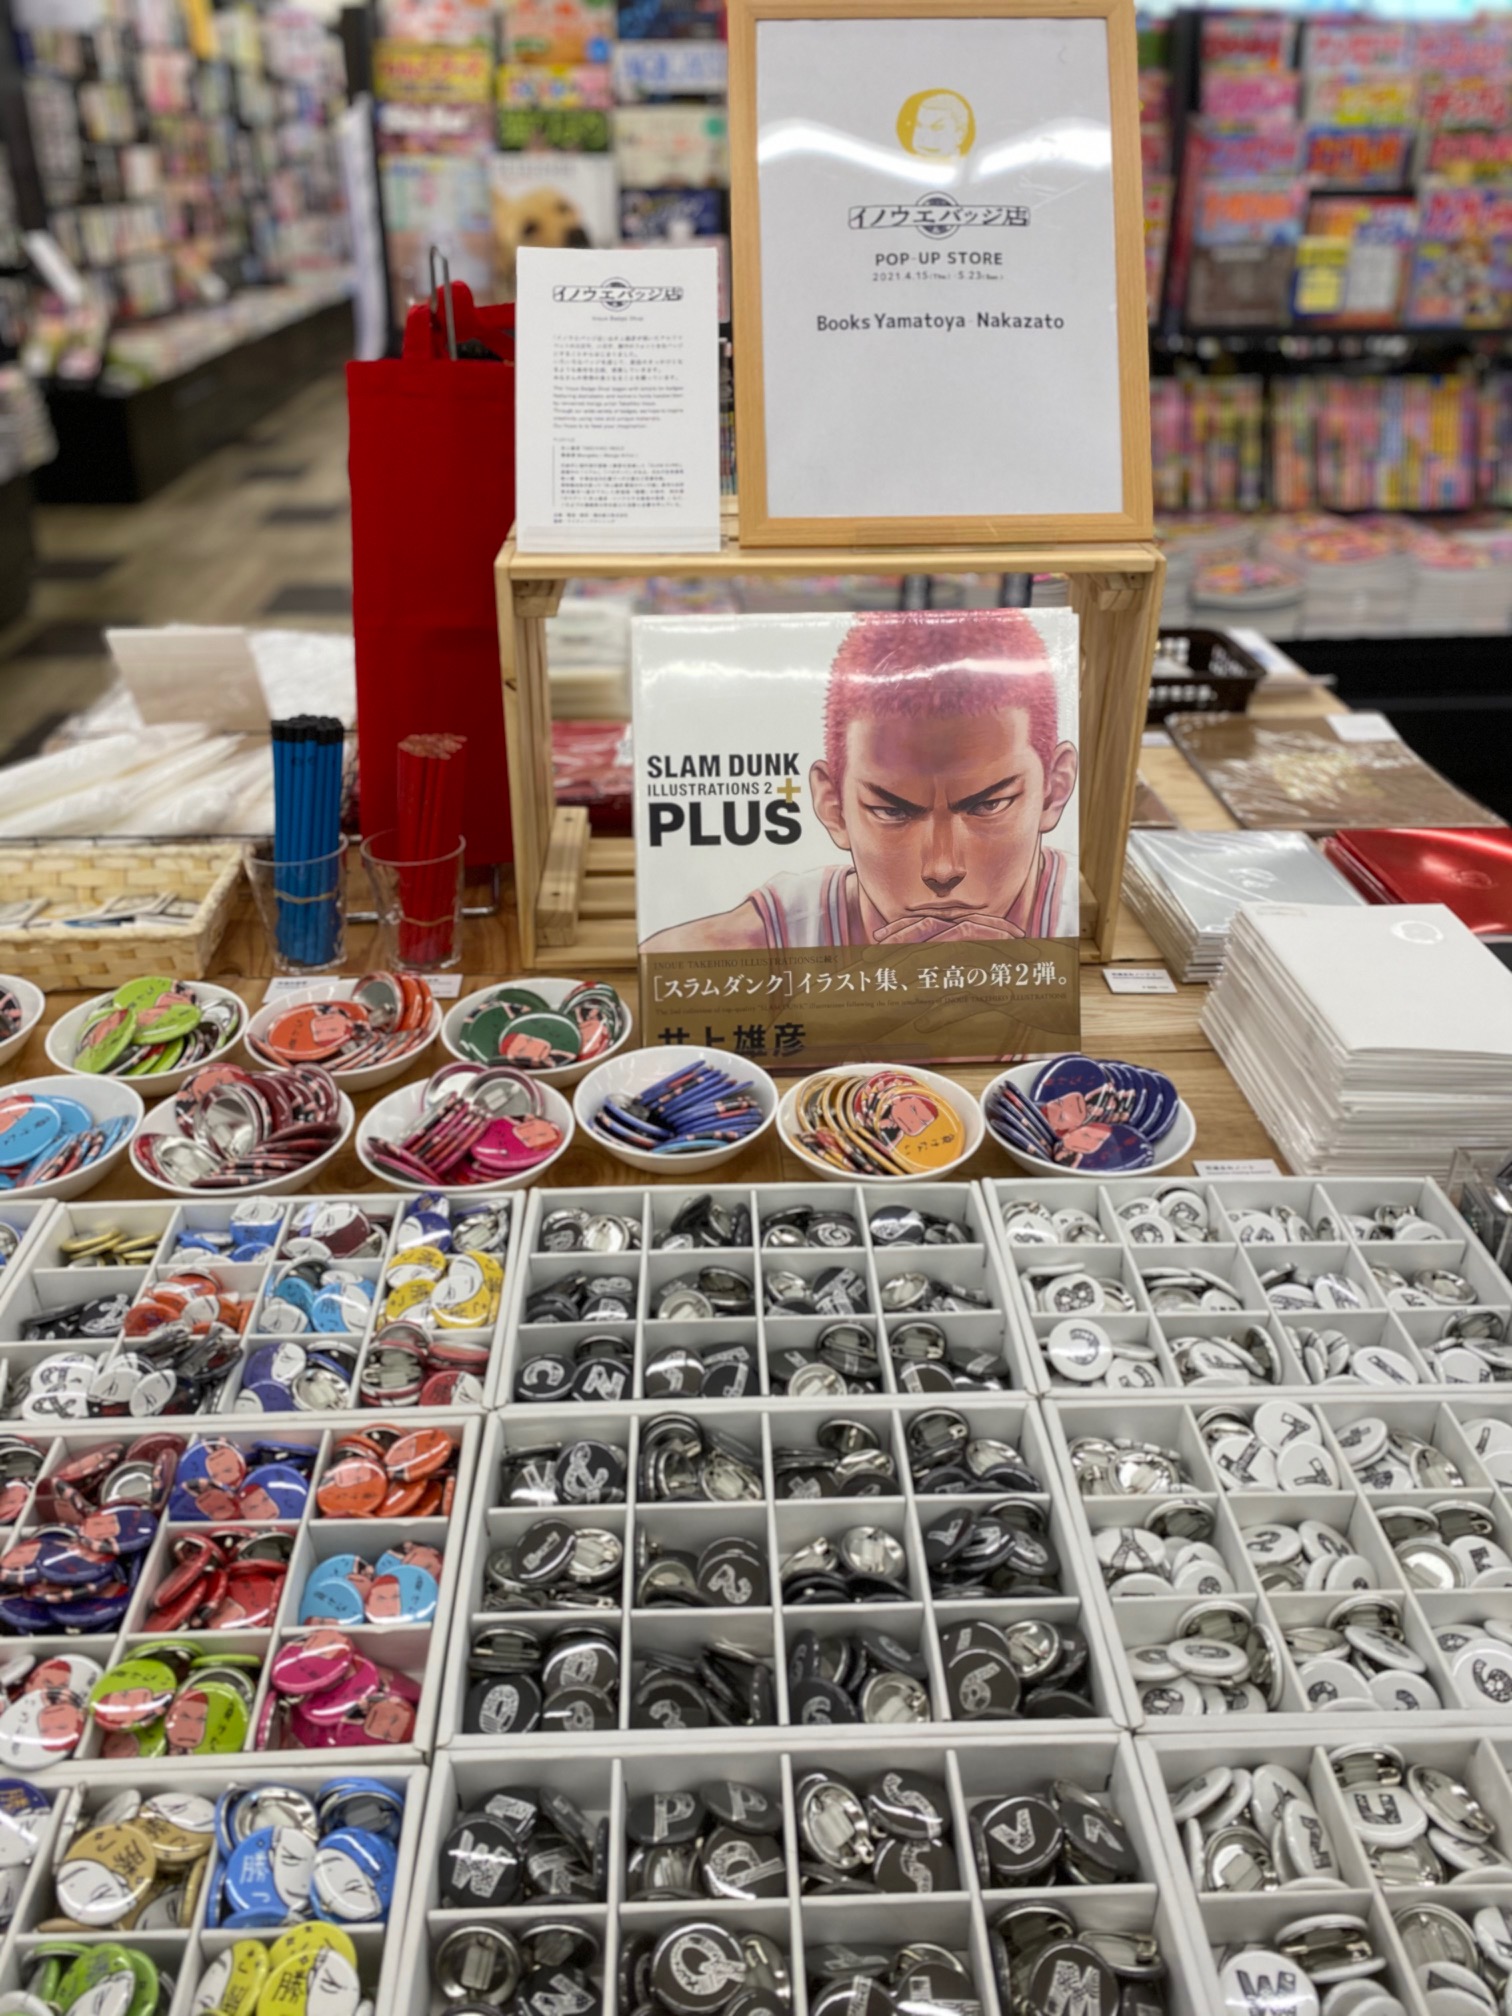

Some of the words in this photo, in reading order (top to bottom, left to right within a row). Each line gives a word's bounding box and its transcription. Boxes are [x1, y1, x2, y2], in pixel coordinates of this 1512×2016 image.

[849, 204, 1030, 229] イノウエバッジ店
[947, 251, 1003, 266] STORE
[552, 285, 684, 303] イノウエバッジ店
[816, 314, 871, 332] Books
[874, 312, 965, 332] Yamatoya
[976, 311, 1065, 329] Nakazato
[647, 754, 721, 779] SLAM
[728, 752, 800, 777] DUNK
[647, 781, 760, 797] ILLUSTRATIONS
[764, 781, 773, 795] 2
[648, 799, 803, 848] PLUS
[653, 961, 684, 971] INOUE
[688, 959, 738, 970] TAKEHIKO
[653, 1790, 696, 1843] P
